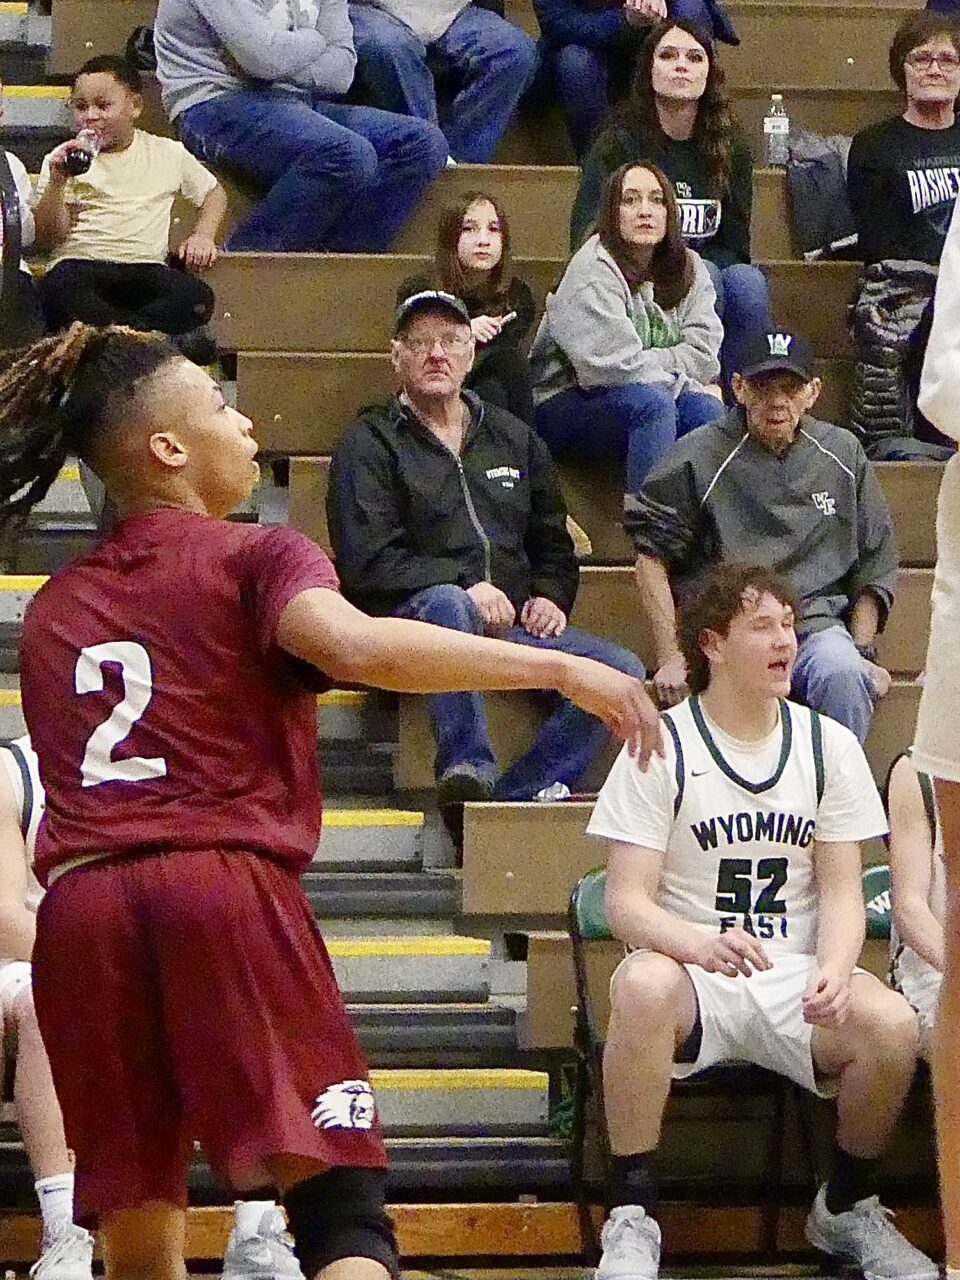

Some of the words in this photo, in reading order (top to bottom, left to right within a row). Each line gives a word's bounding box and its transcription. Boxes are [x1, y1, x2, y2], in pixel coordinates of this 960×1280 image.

[75, 640, 168, 788] 2
[689, 811, 816, 852] WYOMING
[715, 856, 789, 914] 52
